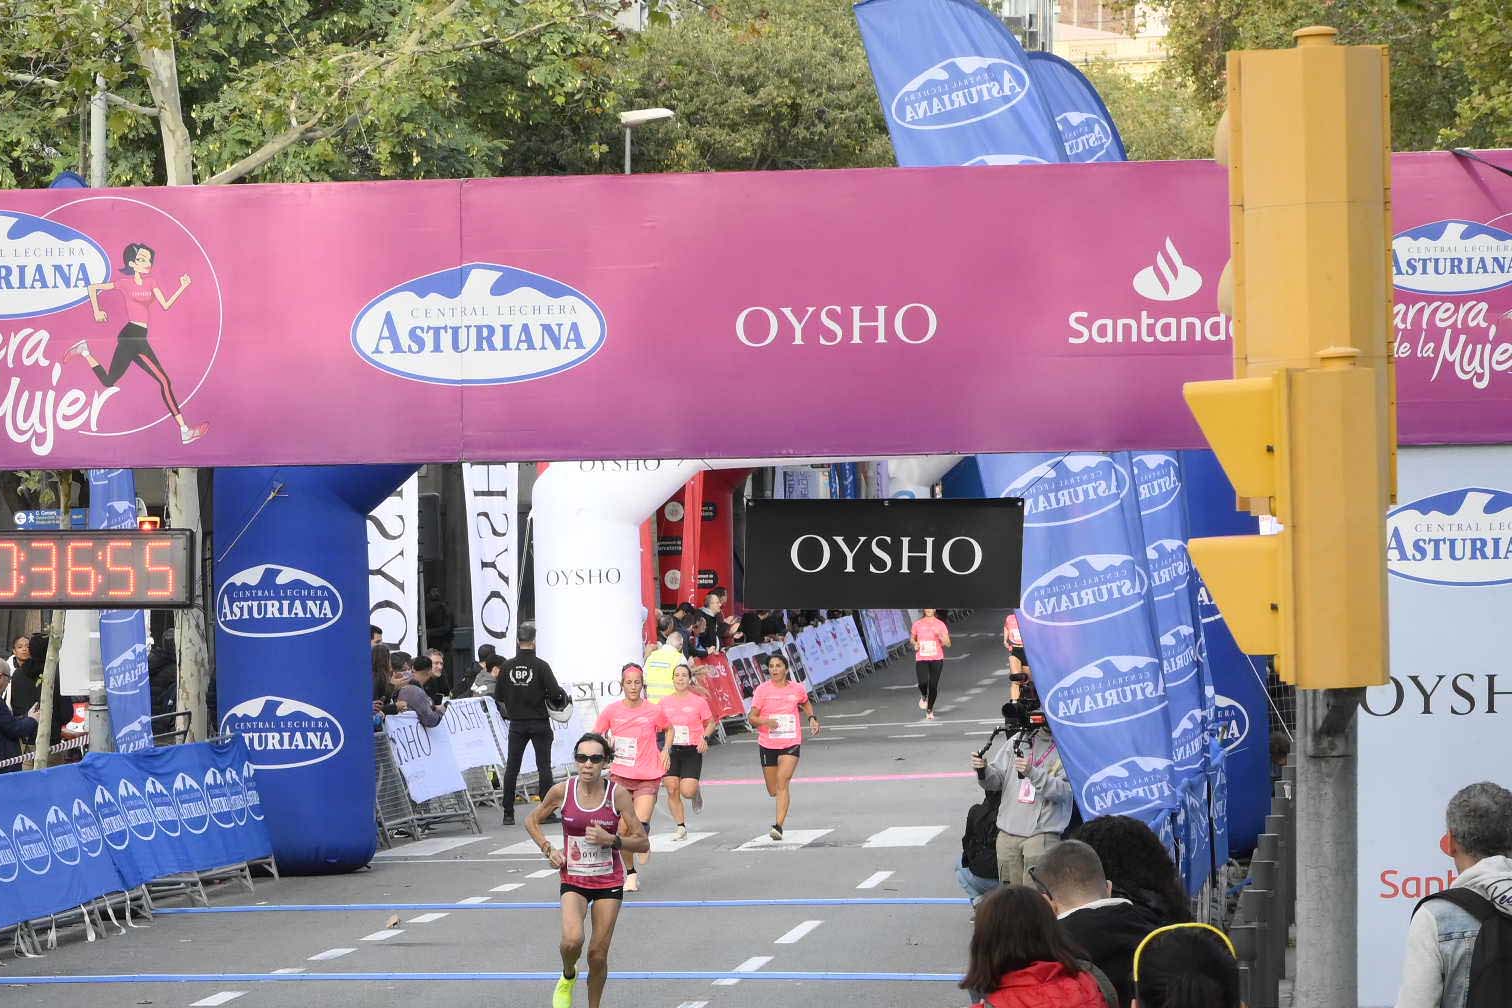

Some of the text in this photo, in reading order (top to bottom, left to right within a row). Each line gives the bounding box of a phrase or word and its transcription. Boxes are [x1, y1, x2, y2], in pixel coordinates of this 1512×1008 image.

[12, 247, 87, 257] LECHERA
[1407, 245, 1458, 254] CENTRAL
[411, 303, 578, 318] CENTRAL LECHERA
[1393, 300, 1490, 330] arrera
[371, 310, 586, 355] ASTURIANA
[735, 303, 937, 347] OYSHO
[1068, 310, 1231, 343] Santand
[1417, 330, 1435, 358] la
[1431, 325, 1512, 389] Muje
[1414, 522, 1481, 533] CENTRAL
[790, 534, 983, 575] OYSHO
[546, 567, 621, 587] OYSHO
[233, 588, 329, 598] CENTRAL LECHERA
[220, 593, 333, 622] ASTURIANA
[515, 670, 528, 679] BP
[1360, 672, 1512, 717] OYSH
[235, 720, 330, 730] CENTRAL LECHERA
